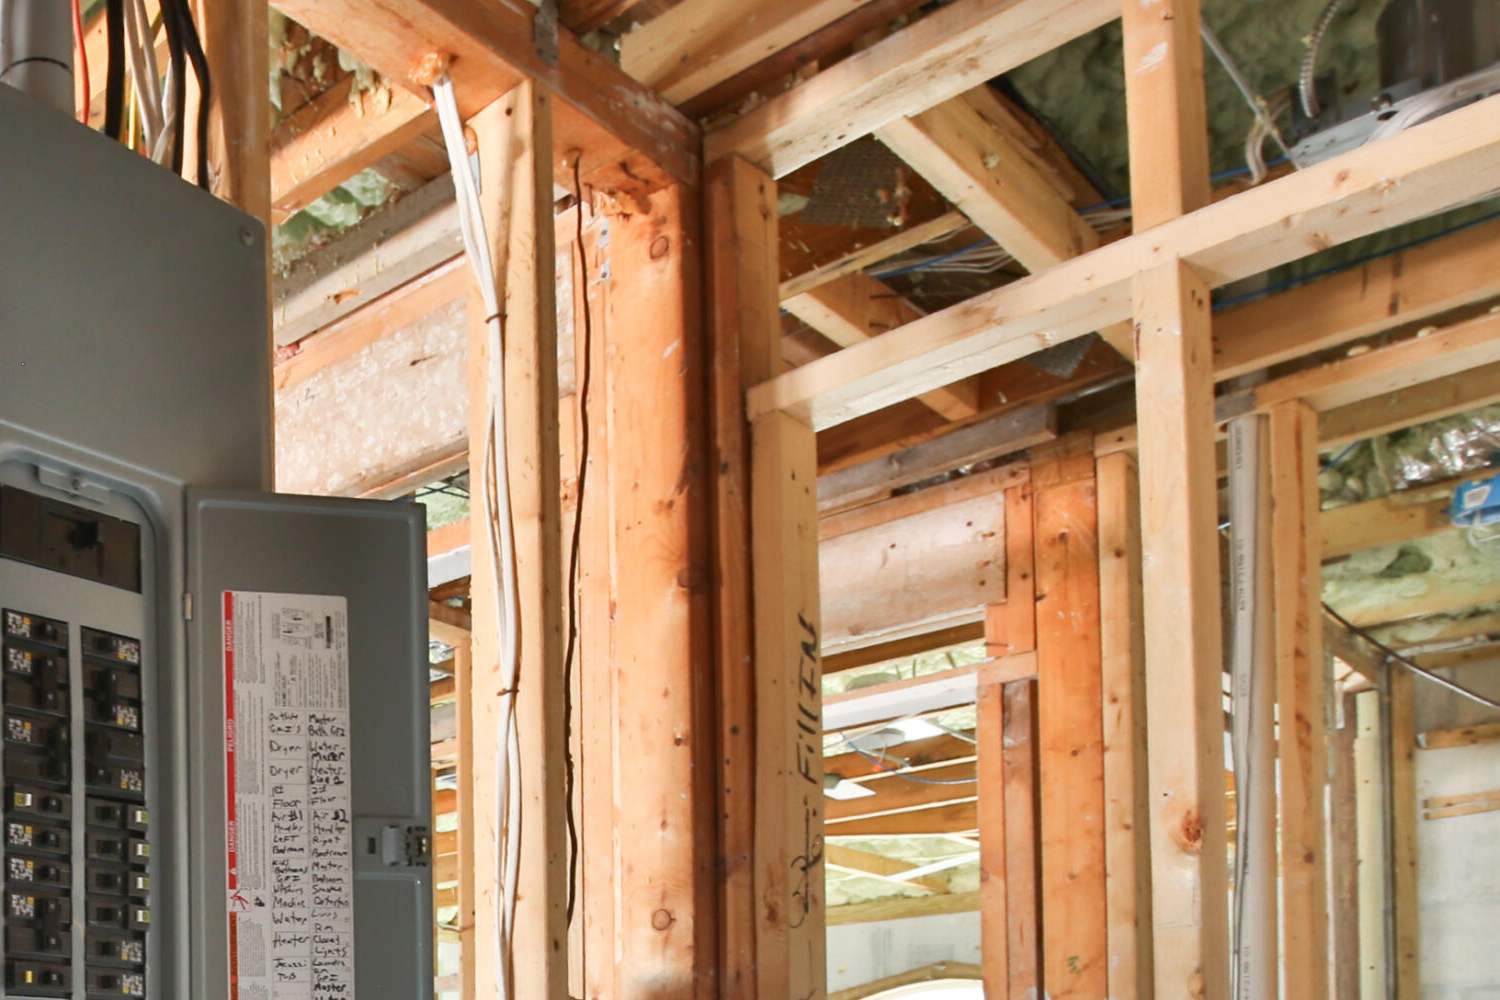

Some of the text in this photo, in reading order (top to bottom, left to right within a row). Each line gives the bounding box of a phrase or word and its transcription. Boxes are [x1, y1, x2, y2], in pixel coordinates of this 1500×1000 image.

[309, 713, 337, 724] Master
[269, 740, 302, 755] Dryer
[269, 765, 303, 779] Dryer
[273, 799, 301, 809] Floor
[272, 912, 308, 925] Water
[273, 931, 309, 948] Heater
[314, 982, 347, 992] Master
